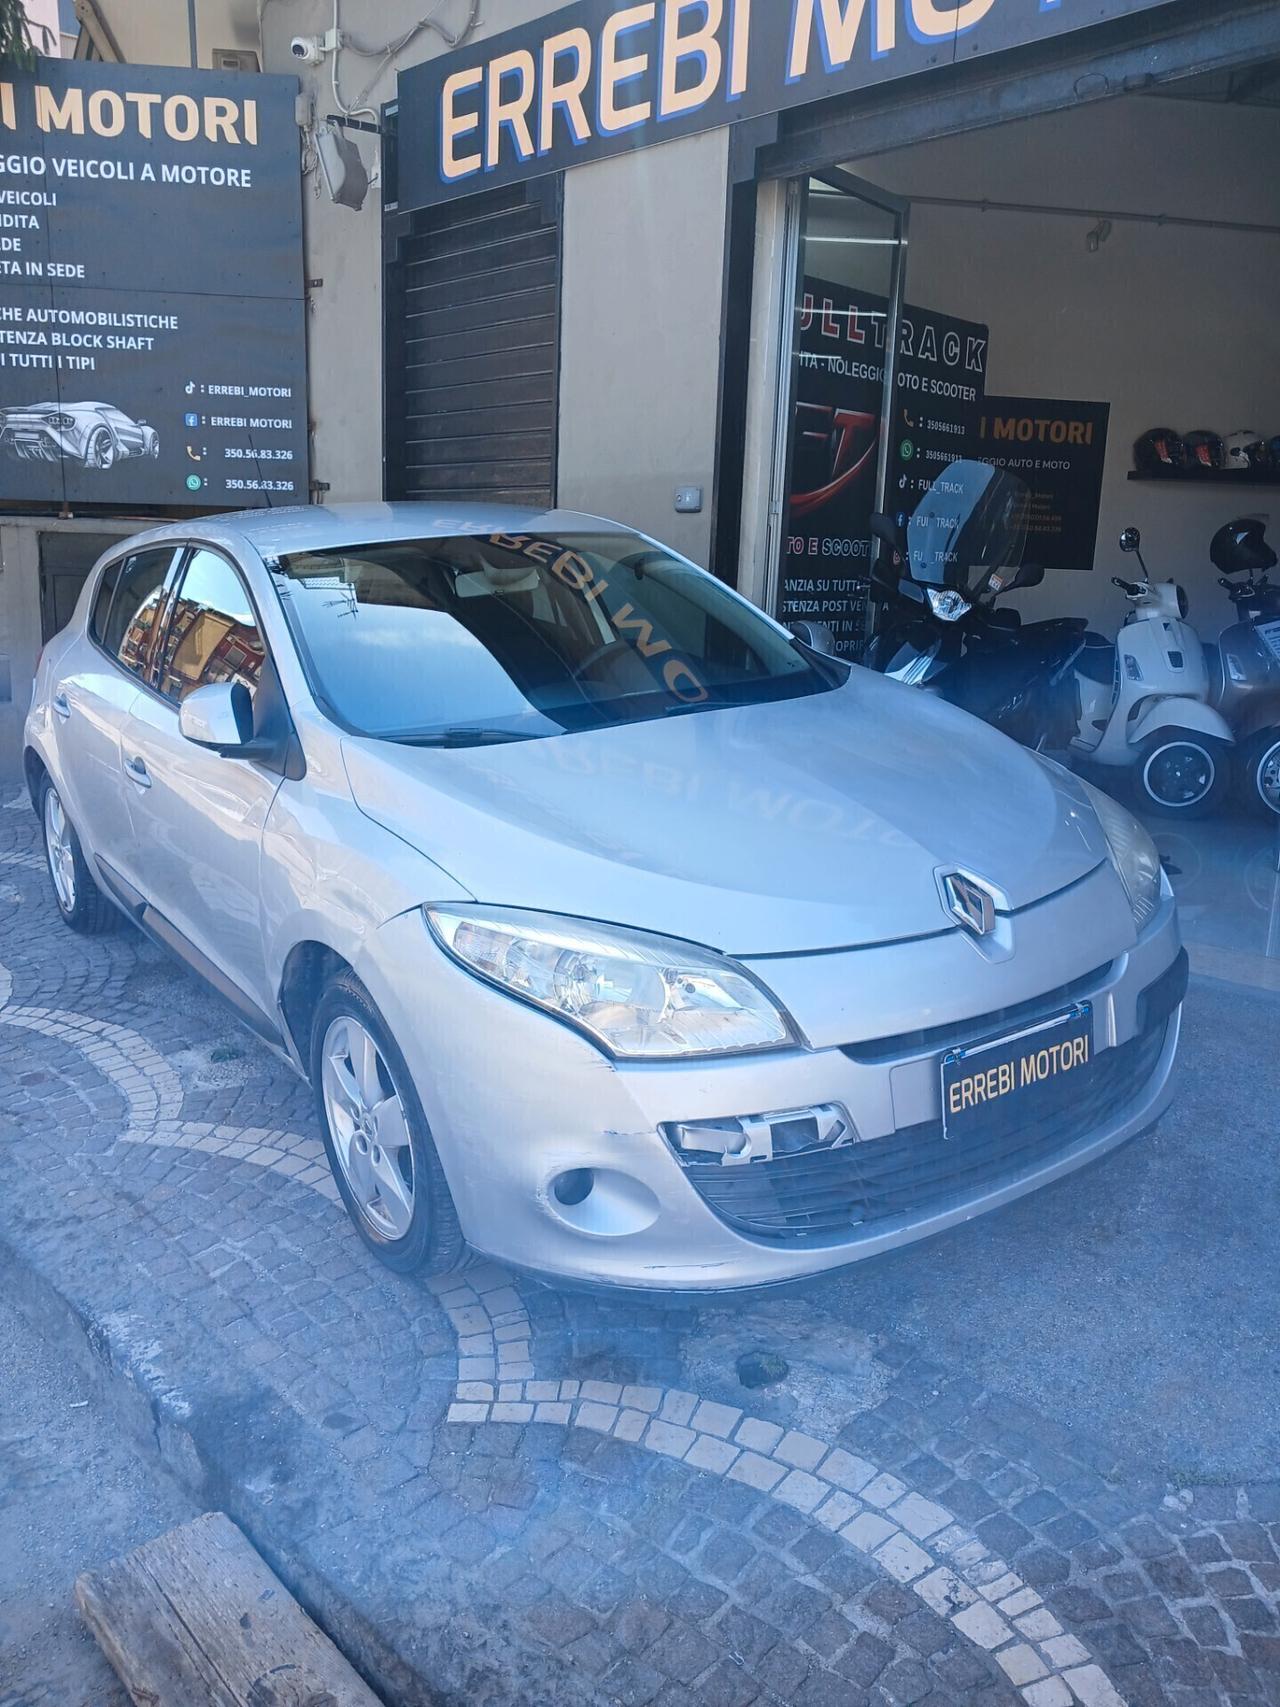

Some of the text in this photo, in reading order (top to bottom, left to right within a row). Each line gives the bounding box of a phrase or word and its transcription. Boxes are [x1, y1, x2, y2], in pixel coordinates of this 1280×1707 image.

[441, 0, 749, 182] ERREBI
[34, 85, 258, 146] MOTORI
[52, 157, 135, 181] VEICOLI
[140, 163, 156, 181] A
[161, 164, 252, 188] MOTORE
[0, 213, 40, 229] DITA
[0, 237, 21, 252] DE
[0, 260, 85, 279] TA IN SEDE
[0, 307, 179, 330] HE AUTOMOBILISTICHE
[51, 332, 103, 349] BLOCK
[106, 335, 155, 351] SHAFT
[9, 353, 53, 369] TUTTI
[57, 355, 63, 370] I
[65, 356, 96, 371] TIPI
[208, 384, 292, 398] ERREBI_MOTORI
[921, 377, 928, 392] E
[930, 379, 976, 402] SCOOTER
[210, 416, 248, 428] ERREBI
[249, 417, 293, 429] MOTORI
[993, 417, 1093, 445] MOTORI
[224, 448, 294, 460] 350.56.83.326
[1008, 459, 1033, 469] AUTO
[1035, 460, 1041, 469] E
[1042, 460, 1070, 470] MOTO
[225, 479, 294, 491] 350.56.83.326
[808, 537, 818, 555] E
[816, 580, 830, 592] SU
[832, 580, 862, 592] TUTT
[822, 600, 848, 612] POST
[841, 621, 853, 632] IN
[950, 1034, 1089, 1114] ERREBI MOTORI
